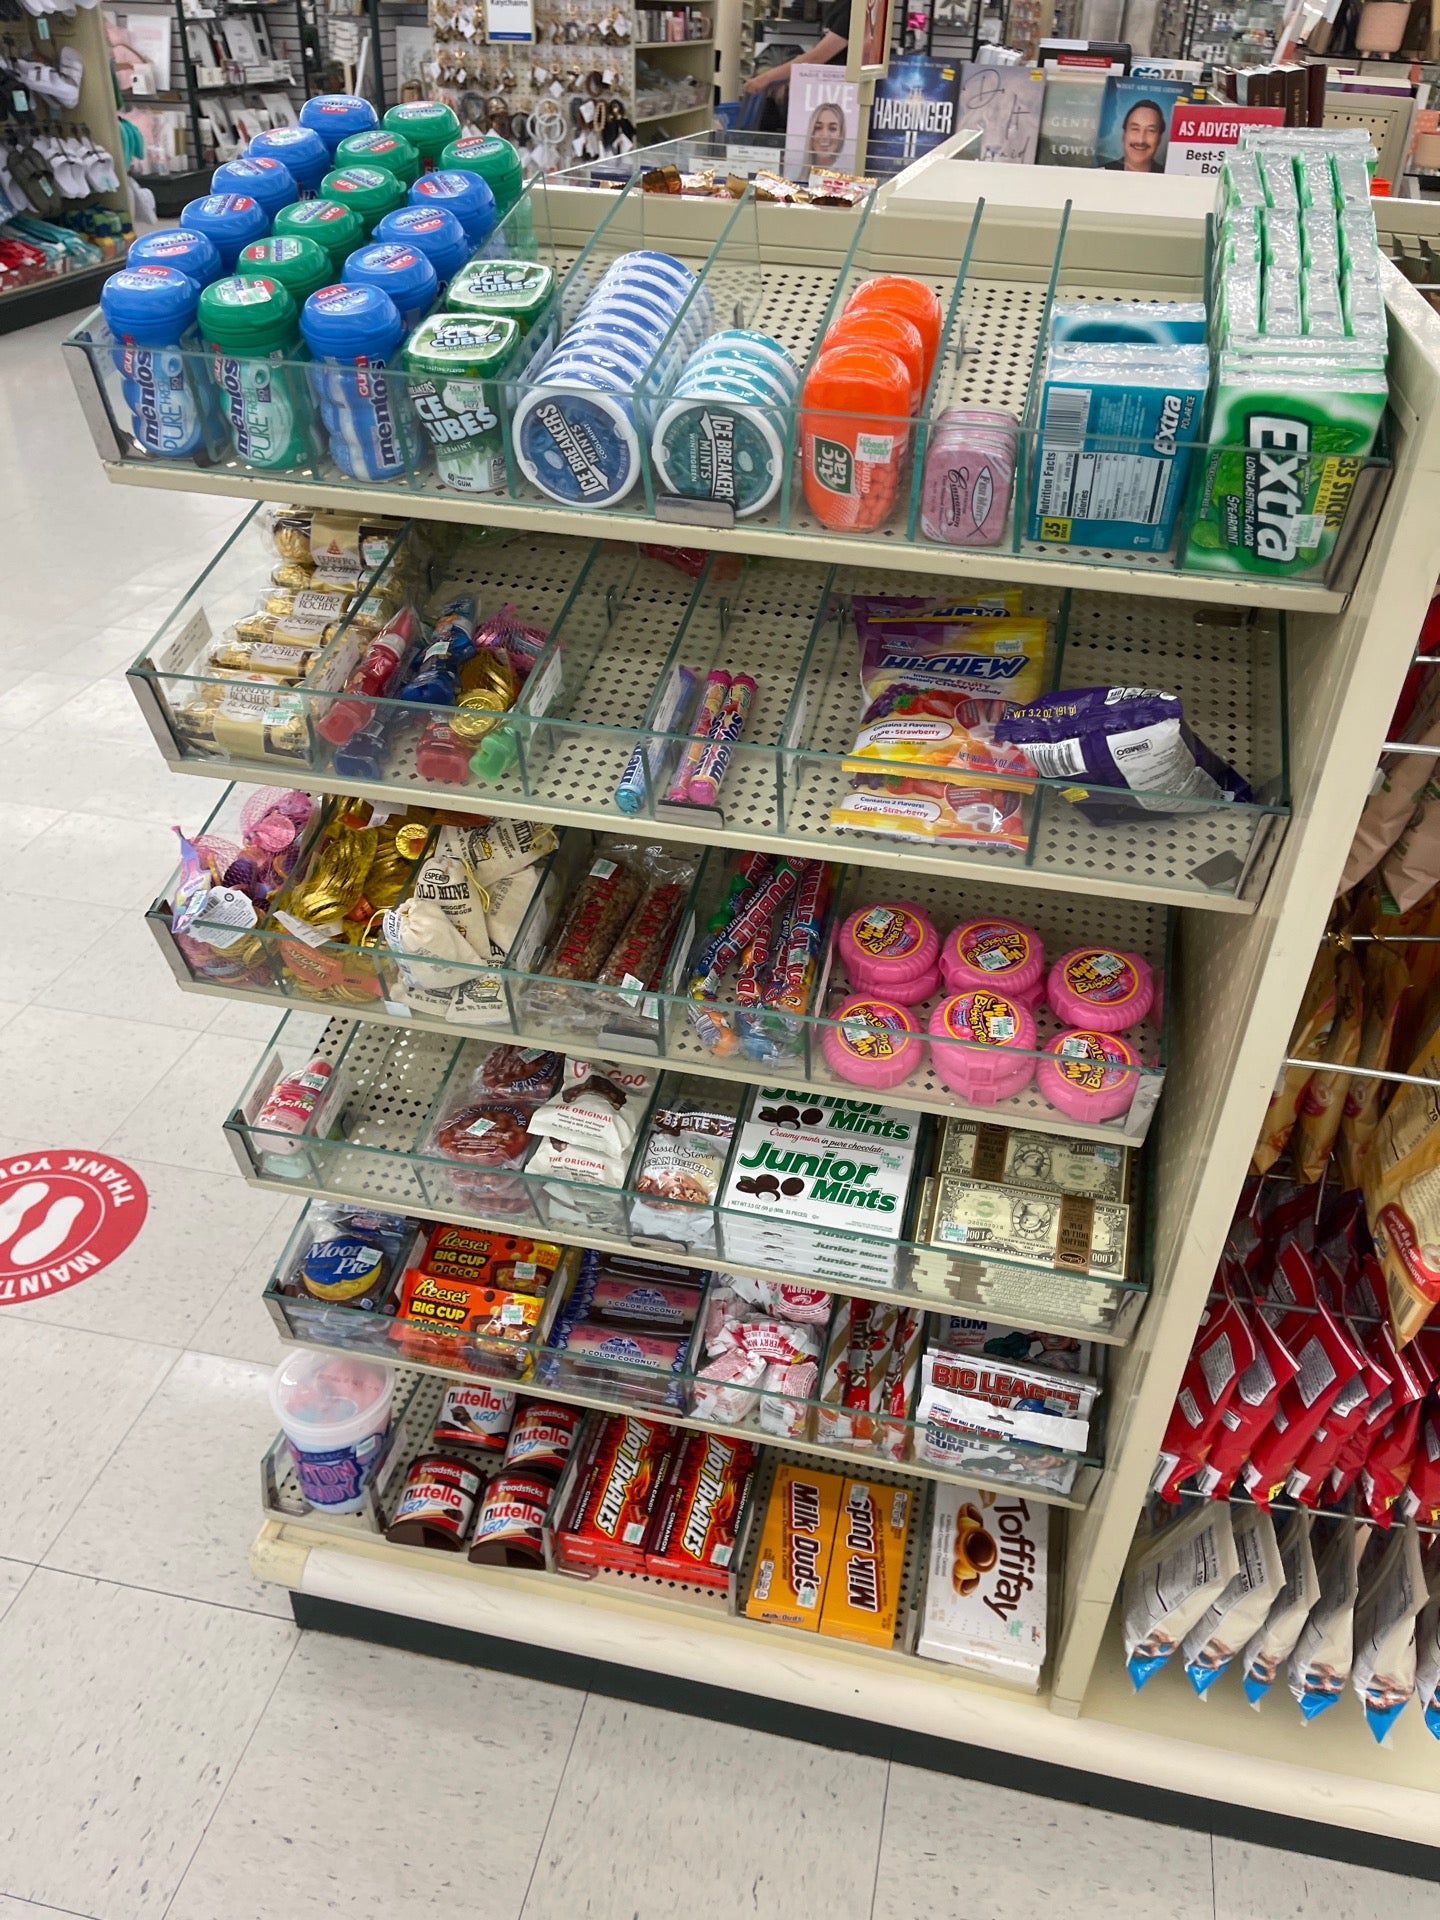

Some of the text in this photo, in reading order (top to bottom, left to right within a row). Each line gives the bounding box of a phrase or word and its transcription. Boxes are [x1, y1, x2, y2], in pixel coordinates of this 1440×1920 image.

[804, 83, 854, 113] LIVE
[873, 97, 953, 134] HARBINGER
[1179, 121, 1195, 136] AS
[468, 280, 537, 295] CUBES
[472, 275, 506, 287] ICE
[430, 333, 502, 348] CUBES
[435, 330, 469, 340] ICE
[137, 349, 160, 447] mentos
[224, 356, 250, 456] mentos
[369, 359, 396, 468] mentos
[424, 406, 498, 444] UBES
[536, 403, 602, 497] ICE BREAKERS
[569, 424, 600, 467] MINTS
[688, 432, 697, 483] WINTERGREEN
[711, 414, 735, 498] ICE BREAKER
[699, 438, 713, 481] MINTS
[817, 446, 834, 479] tic
[831, 451, 848, 487] tac
[1039, 452, 1056, 515] Nutrition Facts
[1324, 457, 1358, 528] 35 STICKS
[1077, 489, 1089, 518] Calories
[1243, 456, 1256, 547] LONG LASTING FLAVOR
[1226, 495, 1240, 547] SPEARMINT
[882, 655, 1030, 680] HI-CHEW
[935, 681, 975, 691] Chewy
[957, 679, 991, 689] Fruity
[1014, 709, 1026, 719] WT
[1029, 708, 1041, 718] 3.2
[1043, 707, 1053, 718] OZ
[895, 728, 941, 737] Strawberry
[883, 806, 929, 818] Strawberry
[437, 882, 470, 900] MINE
[729, 868, 797, 950] DUBBLE
[561, 901, 604, 966] PECAN
[572, 1107, 613, 1123] ORIGINAL
[681, 1115, 712, 1130] BITE
[826, 1108, 911, 1142] Mints
[648, 1140, 716, 1162] Russell Stover
[769, 1128, 800, 1144] Creamy
[799, 1134, 821, 1144] mints
[829, 1140, 848, 1150] pure
[848, 1143, 885, 1153] chocolate
[564, 1157, 606, 1171] ORIGINAL
[672, 1157, 713, 1178] DELIGHT
[738, 1139, 880, 1187] Junior
[61, 1156, 136, 1208] THANK
[808, 1178, 899, 1213] Mints
[438, 1231, 491, 1252] Reese's
[812, 1242, 857, 1254] Junior
[332, 1257, 370, 1275] Pie
[434, 1250, 486, 1266] BIG CUP
[0, 1250, 102, 1300] MAINT
[813, 1267, 859, 1279] Junior
[414, 1277, 471, 1304] Reese's
[411, 1300, 466, 1320] BIG CUP
[614, 1301, 642, 1309] COLOR
[644, 1305, 683, 1315] COCONUT
[949, 1317, 988, 1330] GUM
[588, 1350, 616, 1360] COLOR
[618, 1356, 657, 1367] COCONUT
[931, 1362, 978, 1392] BIG
[447, 1390, 501, 1410] nutella
[513, 1426, 570, 1448] nutella
[925, 1434, 965, 1454] GUM
[404, 1483, 463, 1507] nutella
[792, 1481, 820, 1534] Milk
[484, 1503, 544, 1526] nutella
[573, 1490, 591, 1530] CINNAMON
[660, 1512, 676, 1553] CINNAMON
[983, 1497, 1036, 1622] Toffifay
[847, 1555, 878, 1612] Milk
